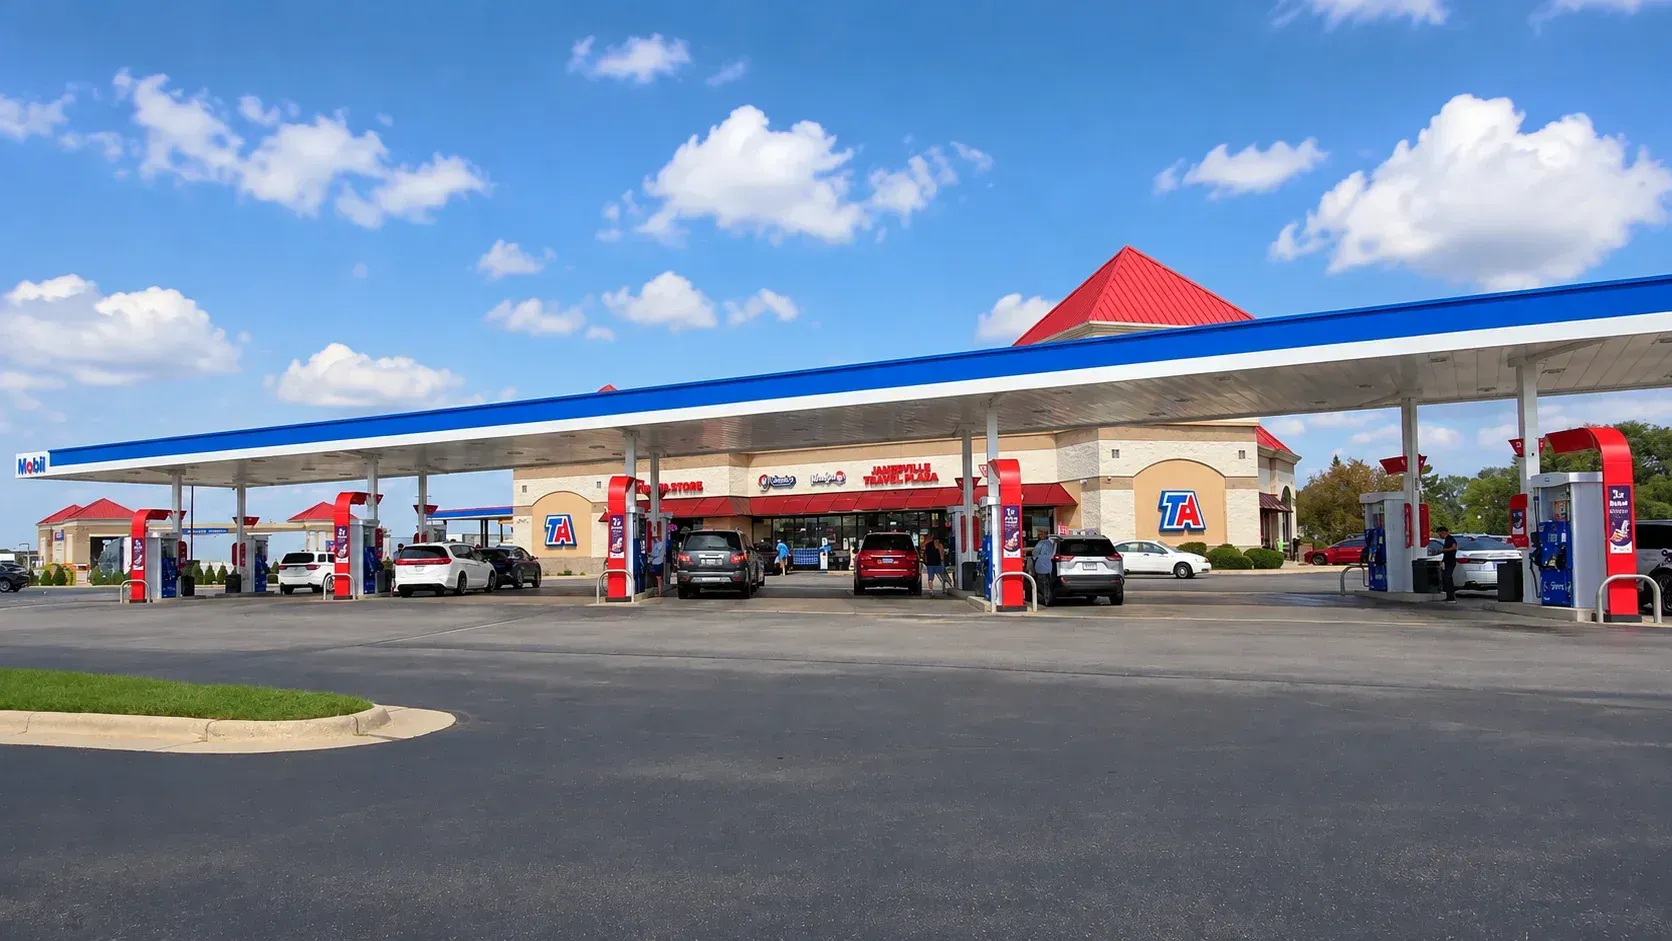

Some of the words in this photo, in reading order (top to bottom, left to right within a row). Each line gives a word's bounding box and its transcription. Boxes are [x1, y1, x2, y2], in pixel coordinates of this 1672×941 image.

[18, 456, 46, 475] Mobil
[671, 481, 703, 492] STORE
[863, 474, 904, 485] TRAVEL
[1160, 490, 1206, 531] TA
[545, 514, 577, 546] TA
